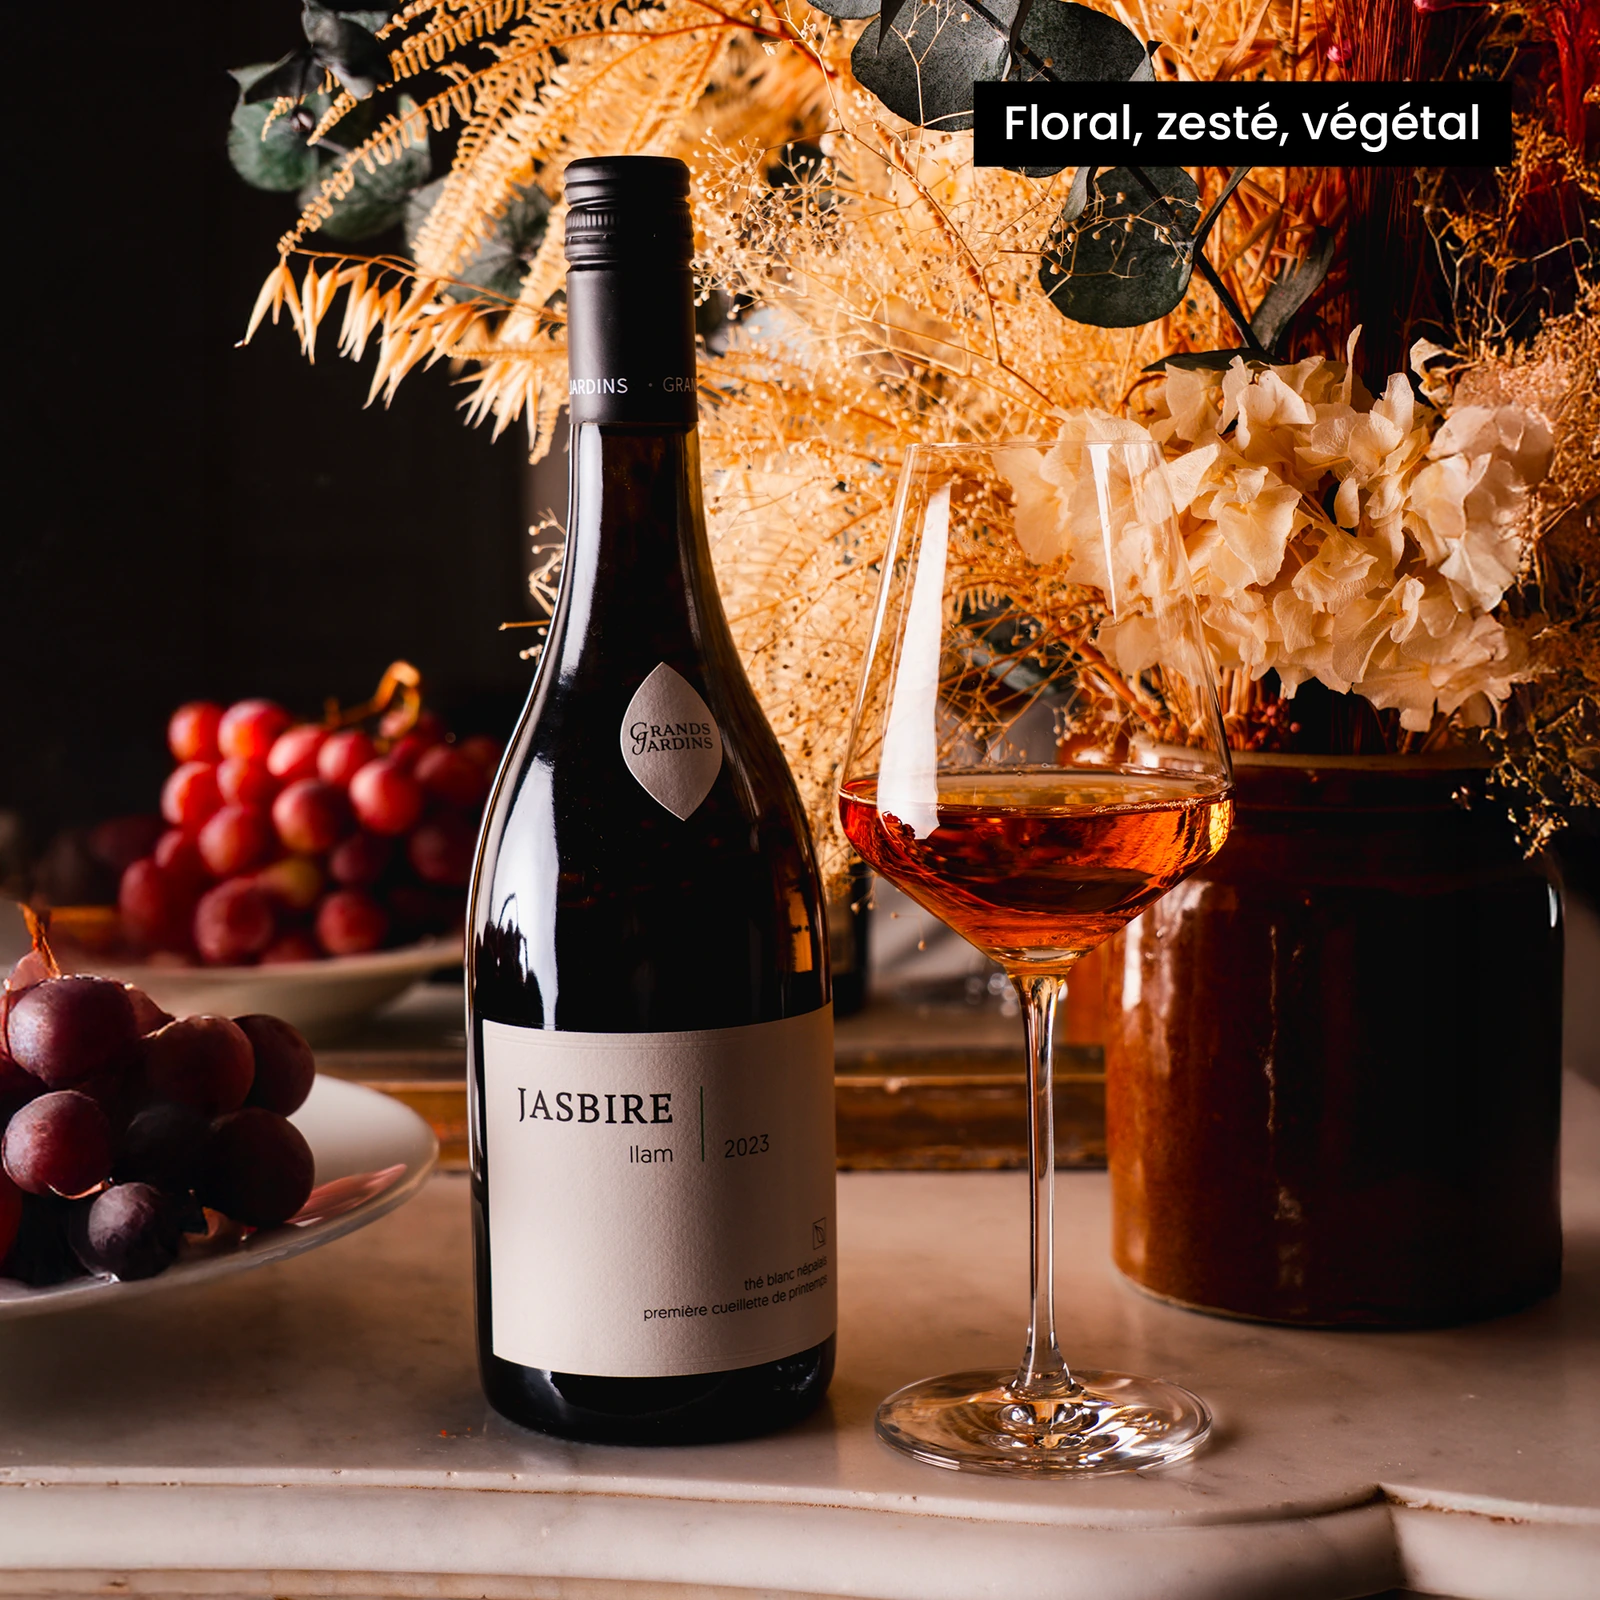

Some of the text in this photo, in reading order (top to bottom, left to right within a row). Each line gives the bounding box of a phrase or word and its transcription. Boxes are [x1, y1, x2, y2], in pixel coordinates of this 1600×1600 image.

[517, 1087, 673, 1124] JASBIRE
[629, 1145, 673, 1164] Ilam
[724, 1134, 770, 1159] 2023
[744, 1255, 827, 1291] thé blanc népalais
[643, 1274, 828, 1321] première cueillette de printemps
